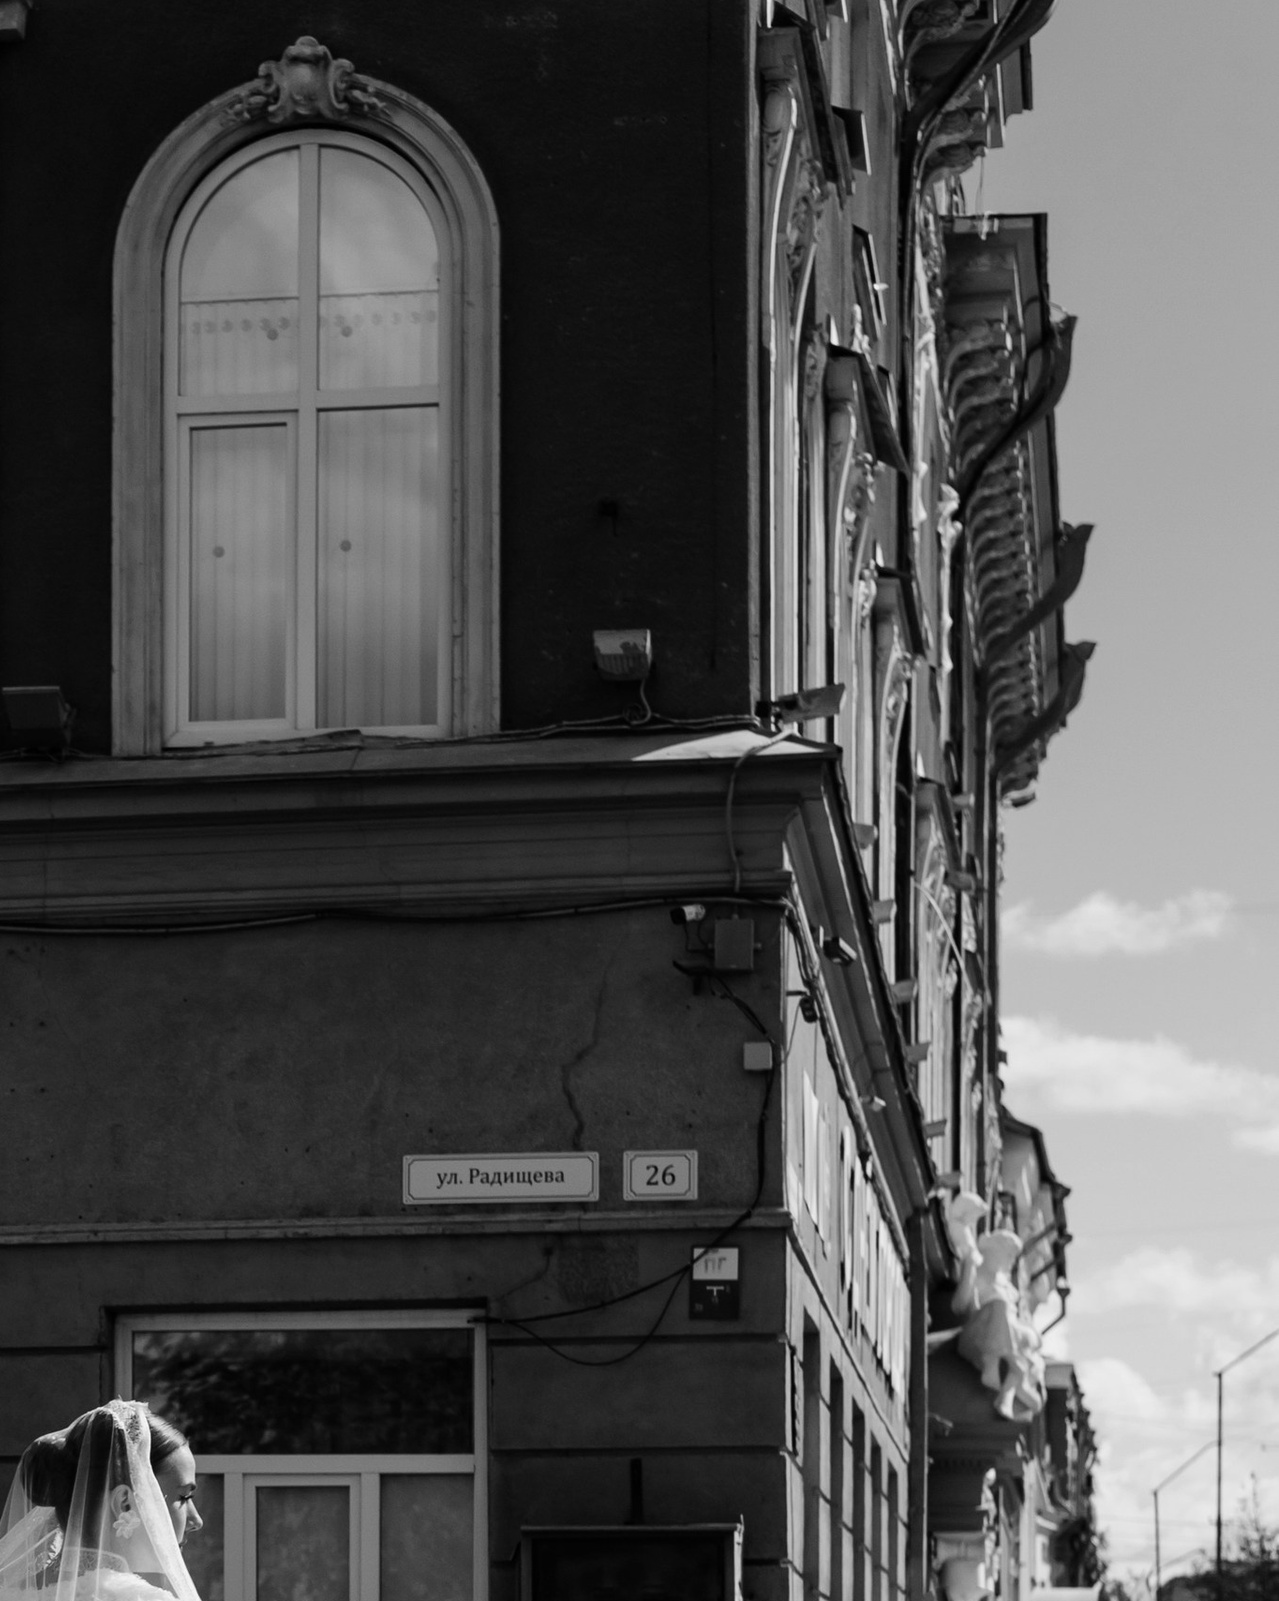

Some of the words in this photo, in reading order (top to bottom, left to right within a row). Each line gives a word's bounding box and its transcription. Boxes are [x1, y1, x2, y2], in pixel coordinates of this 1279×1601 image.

[436, 1172, 463, 1190] ул.
[469, 1167, 566, 1187] Радищева
[645, 1164, 677, 1187] 26
